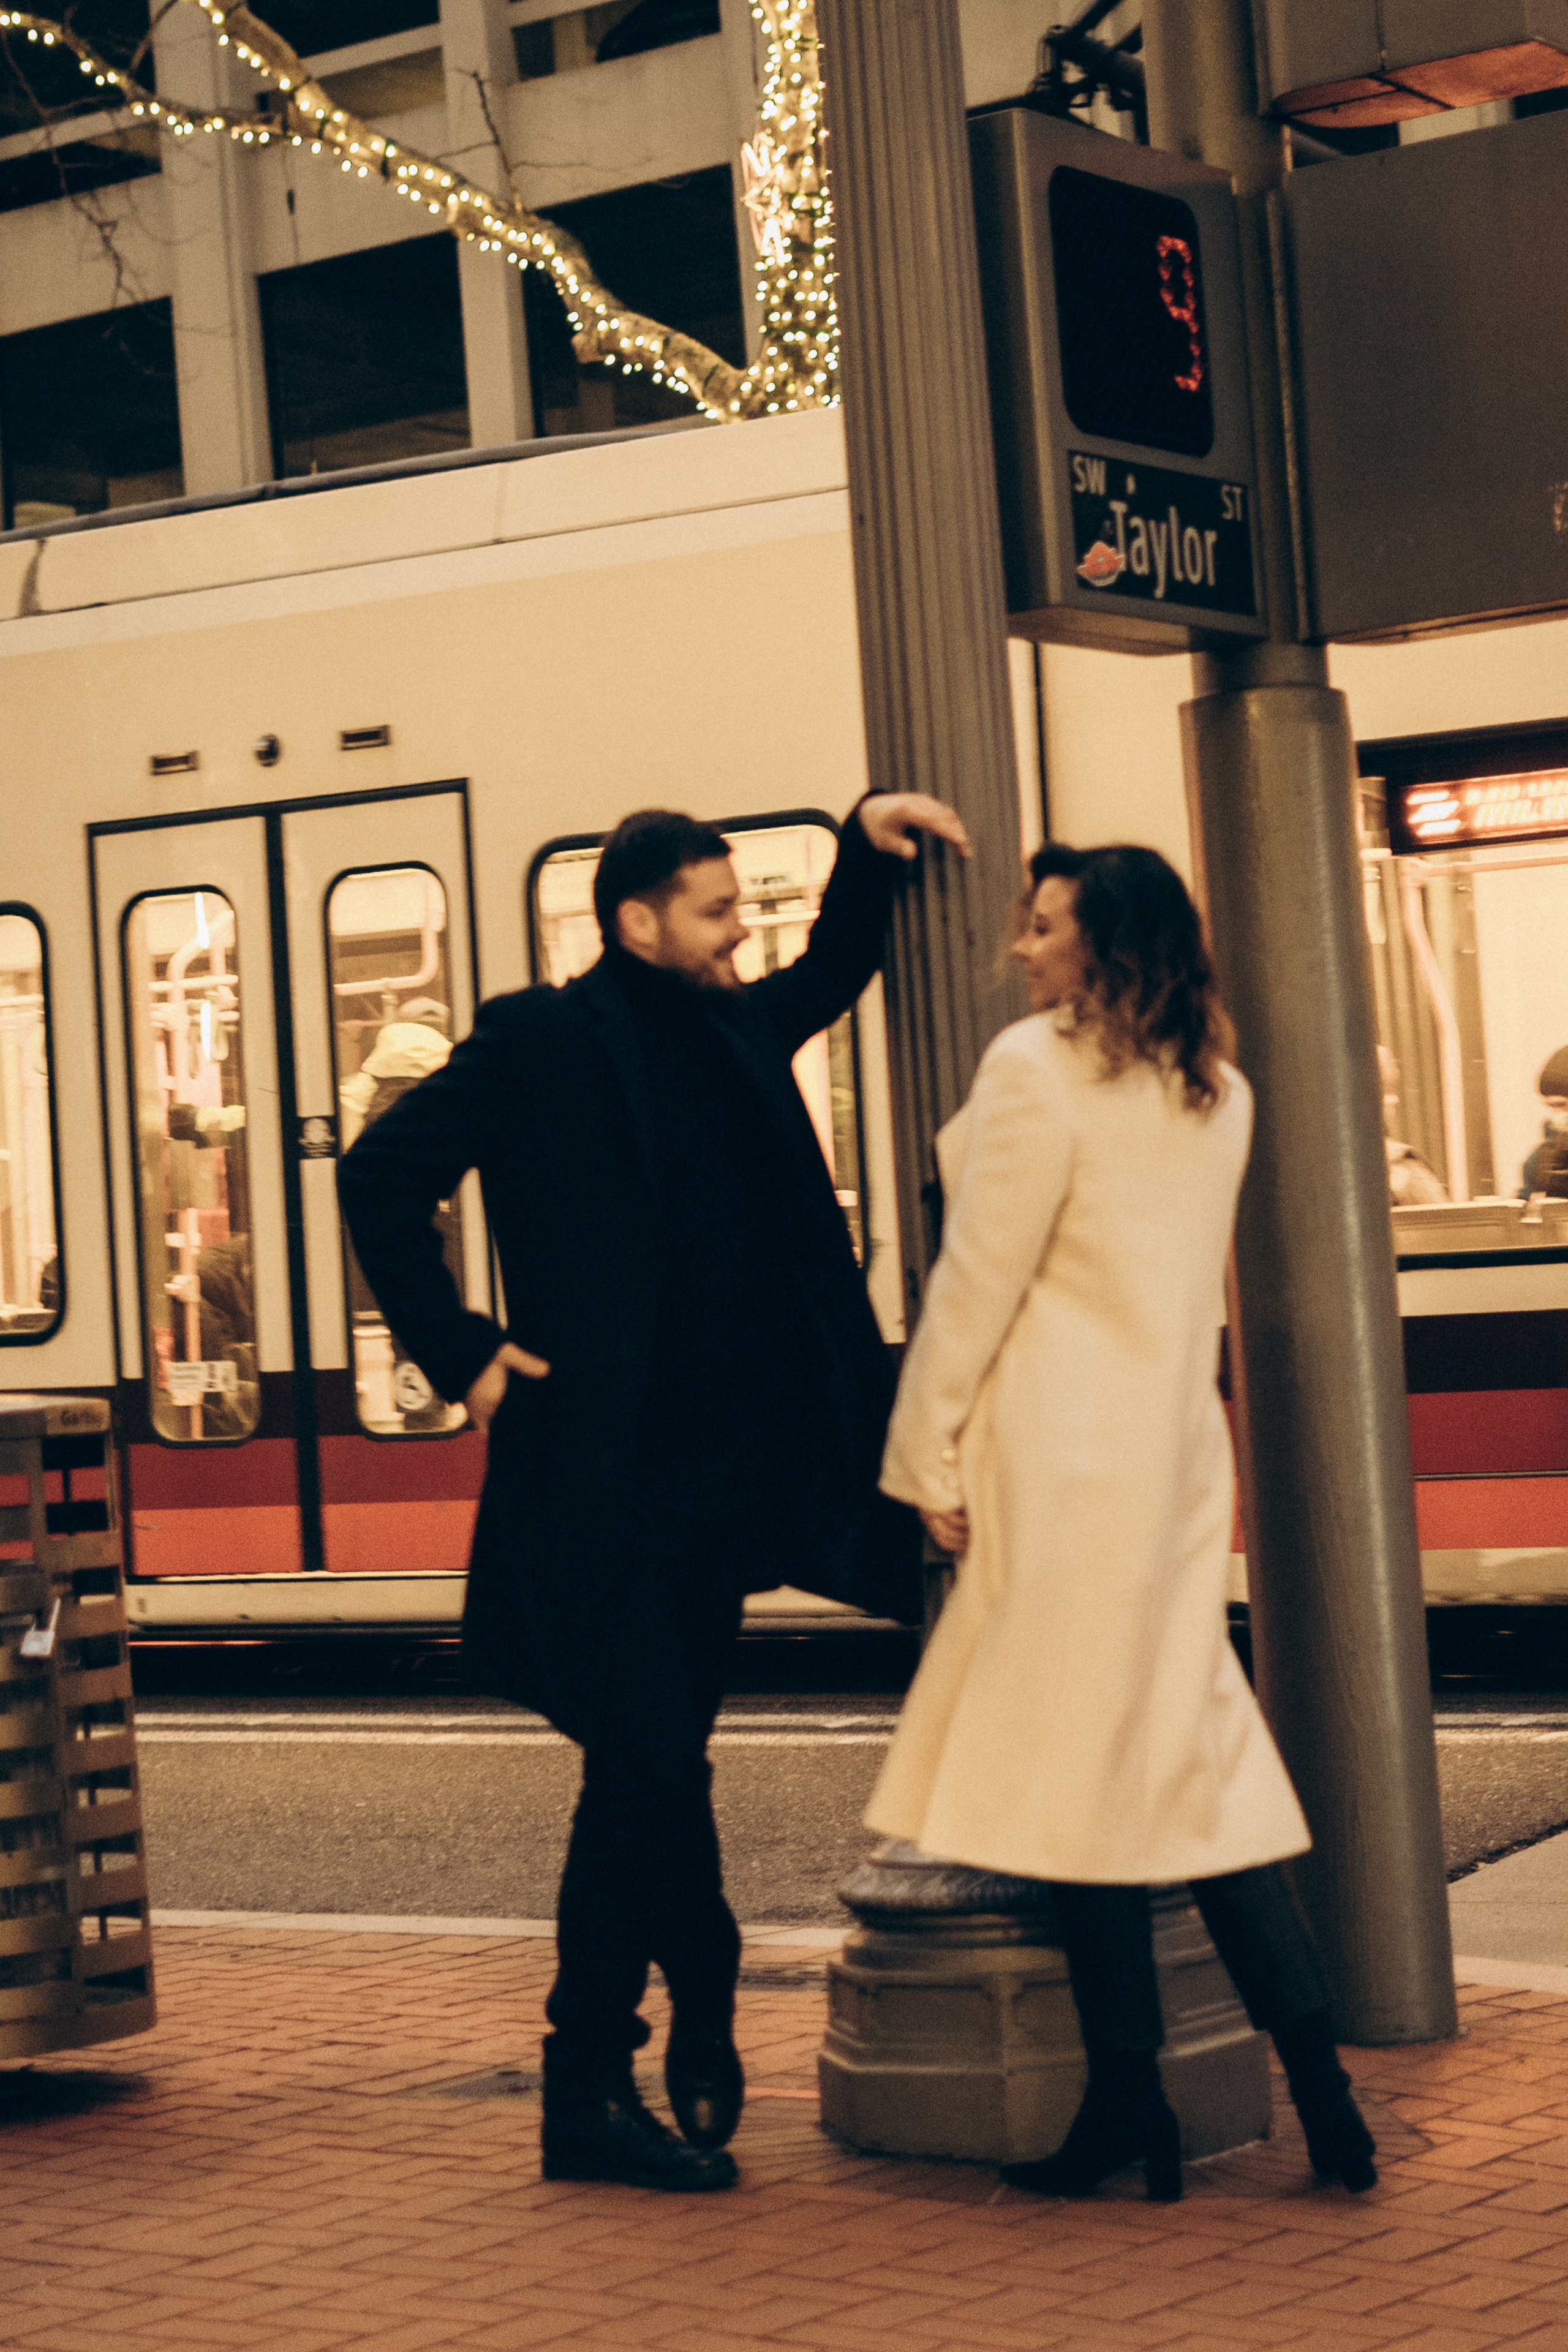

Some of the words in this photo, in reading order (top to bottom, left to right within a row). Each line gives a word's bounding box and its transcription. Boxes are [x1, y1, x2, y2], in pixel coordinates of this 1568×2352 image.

[1156, 235, 1203, 393] 9
[1072, 454, 1107, 496] SW
[1109, 499, 1218, 599] Taylor
[1221, 484, 1243, 521] ST
